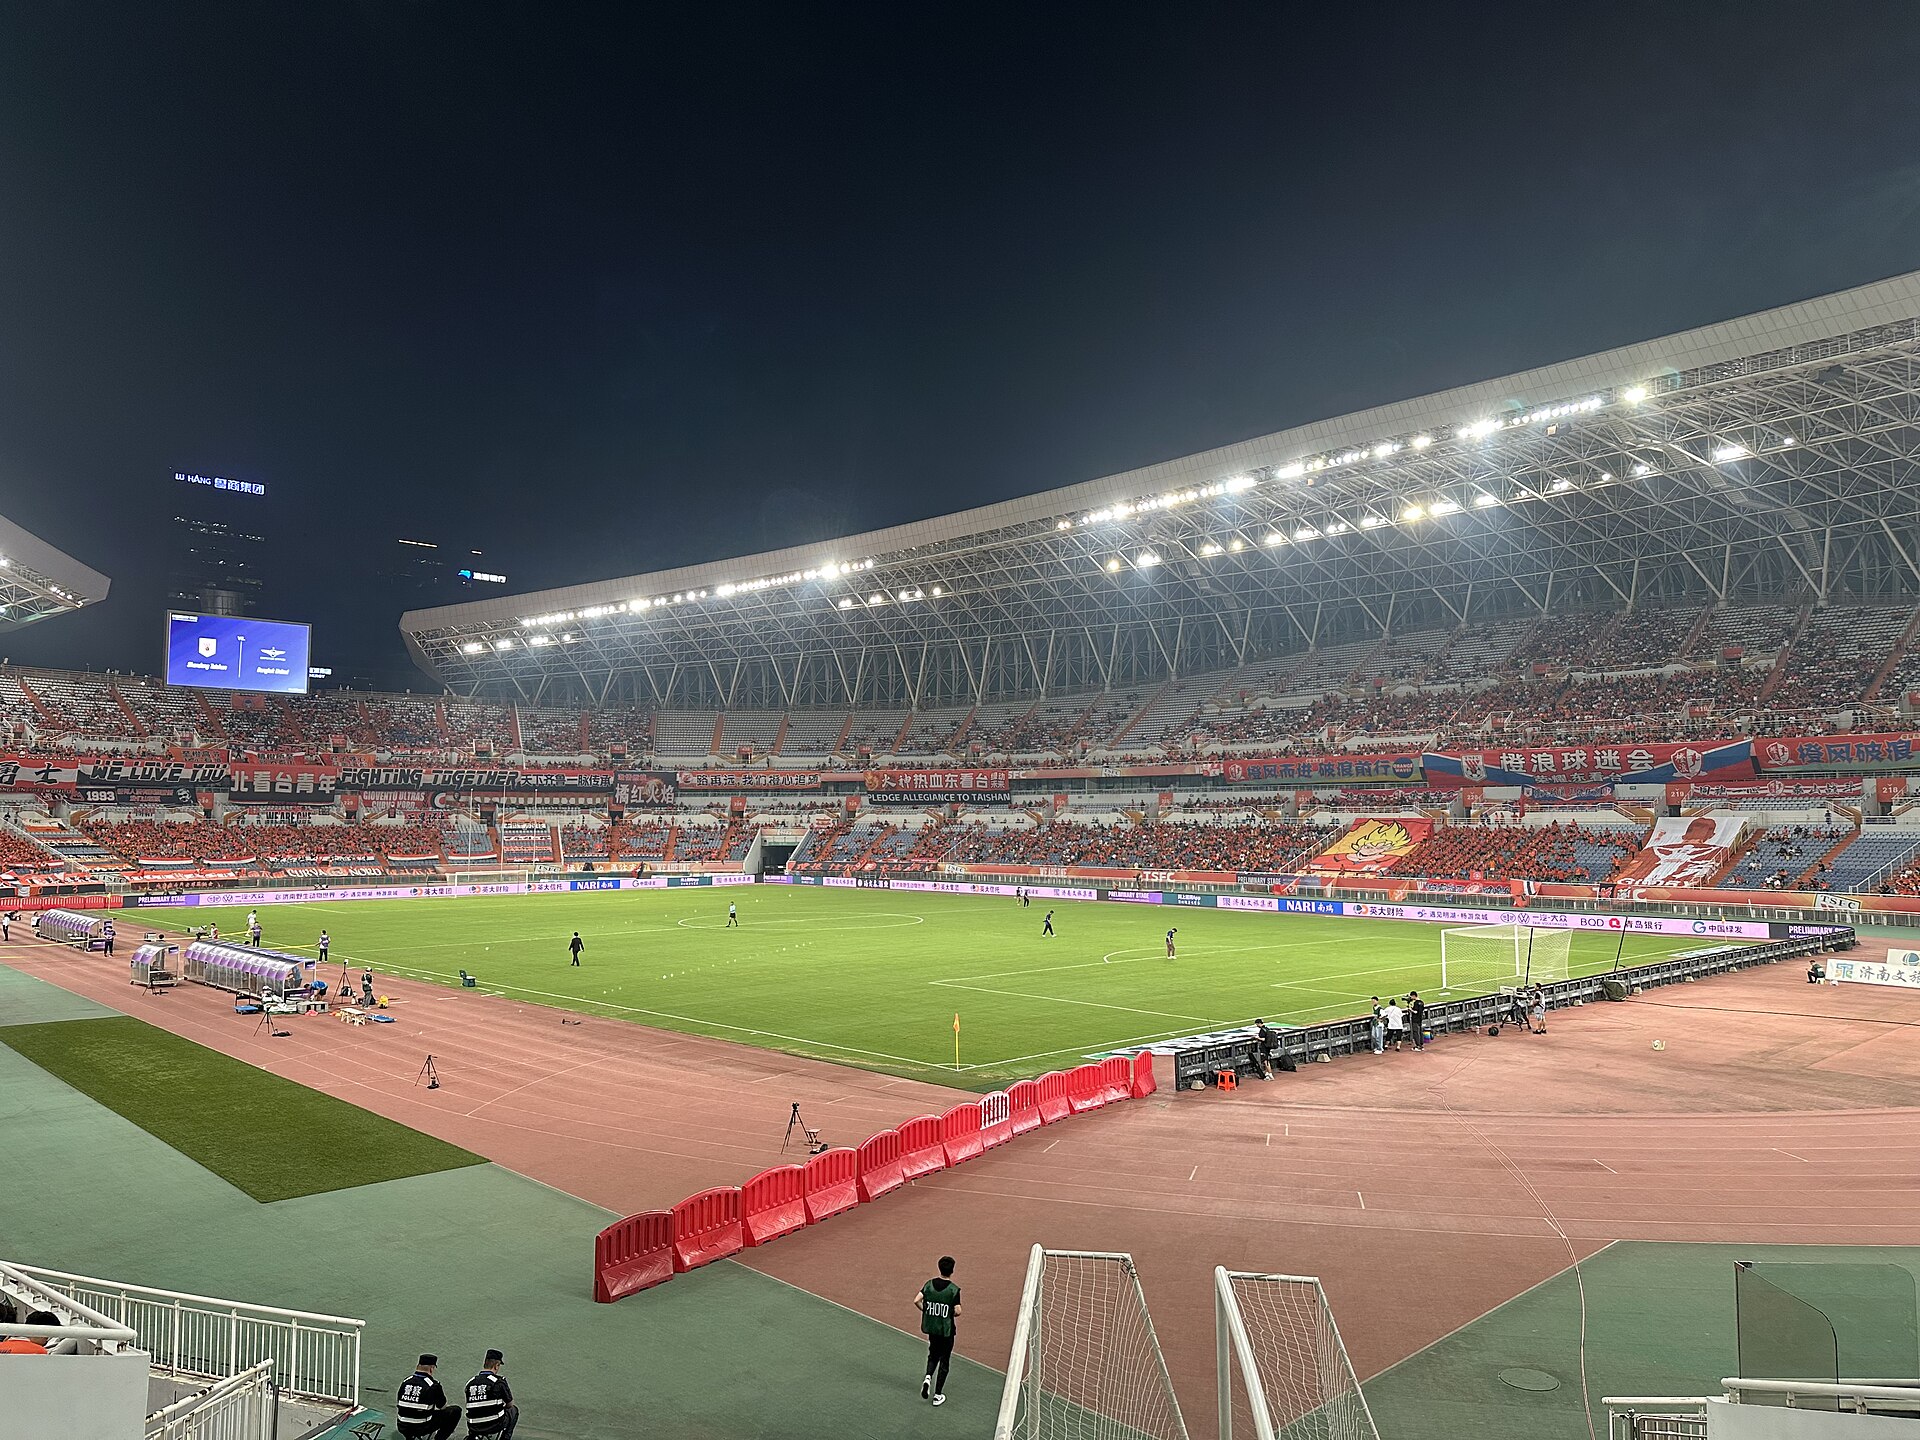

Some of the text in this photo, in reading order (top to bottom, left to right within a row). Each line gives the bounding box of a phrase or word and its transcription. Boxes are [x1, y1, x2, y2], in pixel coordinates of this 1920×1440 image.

[1499, 749, 1654, 774] 橙浪球迷会
[89, 760, 229, 783] WE LOVE YOU
[230, 770, 336, 794] 北看台青年
[520, 774, 613, 786] 天下齐鲁一脉传承
[881, 772, 988, 790] 火神热血东看台
[86, 790, 116, 802] 1993
[399, 791, 426, 801] ULTRAS
[615, 783, 675, 804] 橘红火焰
[868, 793, 900, 802] PLEDGE
[903, 793, 955, 802] ALLEGIANCE
[971, 793, 1010, 802] TAISHAN
[286, 868, 326, 878] CURVA
[350, 866, 382, 876] NORD
[1144, 870, 1176, 882] TSFC
[576, 880, 600, 890] NARI
[1267, 876, 1281, 884] STAGE
[424, 888, 452, 896] 英大集团
[482, 886, 509, 894] 英大财险
[538, 883, 563, 891] 英大信托
[1286, 900, 1334, 913] NARI 南瑞
[1821, 894, 1856, 910] TSFC
[1370, 906, 1404, 917] 英大财险
[1580, 918, 1604, 927] BQD
[1626, 920, 1663, 930] 青岛银行
[1708, 924, 1742, 934] 中国绿发
[1788, 924, 1833, 936] PRELIMINARY
[926, 1301, 949, 1318] PHOTO
[404, 1384, 422, 1396] 警察
[469, 1384, 487, 1396] 警察
[401, 1394, 420, 1402] POLICE
